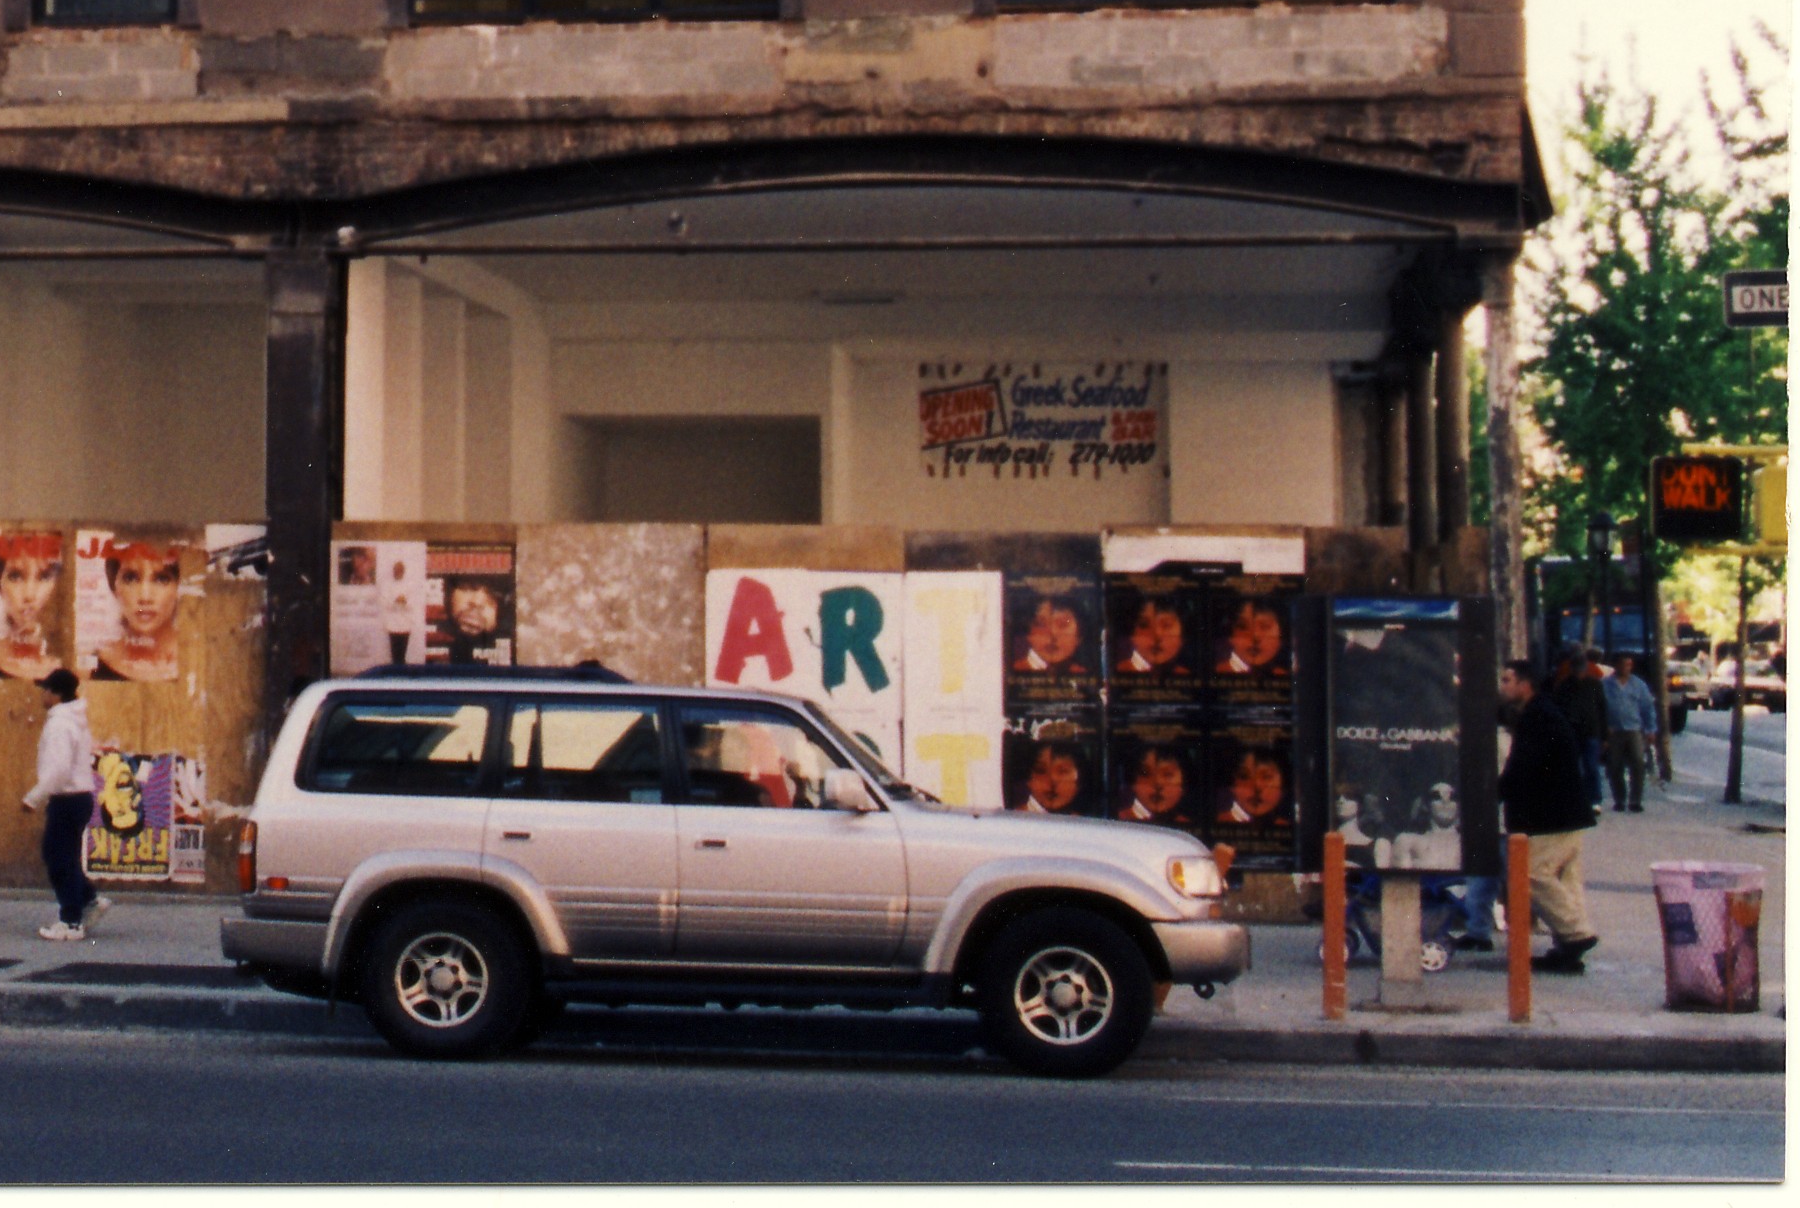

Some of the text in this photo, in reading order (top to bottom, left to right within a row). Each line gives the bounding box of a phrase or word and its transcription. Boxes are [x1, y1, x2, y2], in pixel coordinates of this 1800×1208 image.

[1739, 288, 1789, 309] ONE
[1012, 376, 1151, 408] Greek Seafood
[1663, 486, 1730, 511] WALK
[1336, 726, 1379, 741] DOLCE
[89, 827, 169, 865] FREAK
